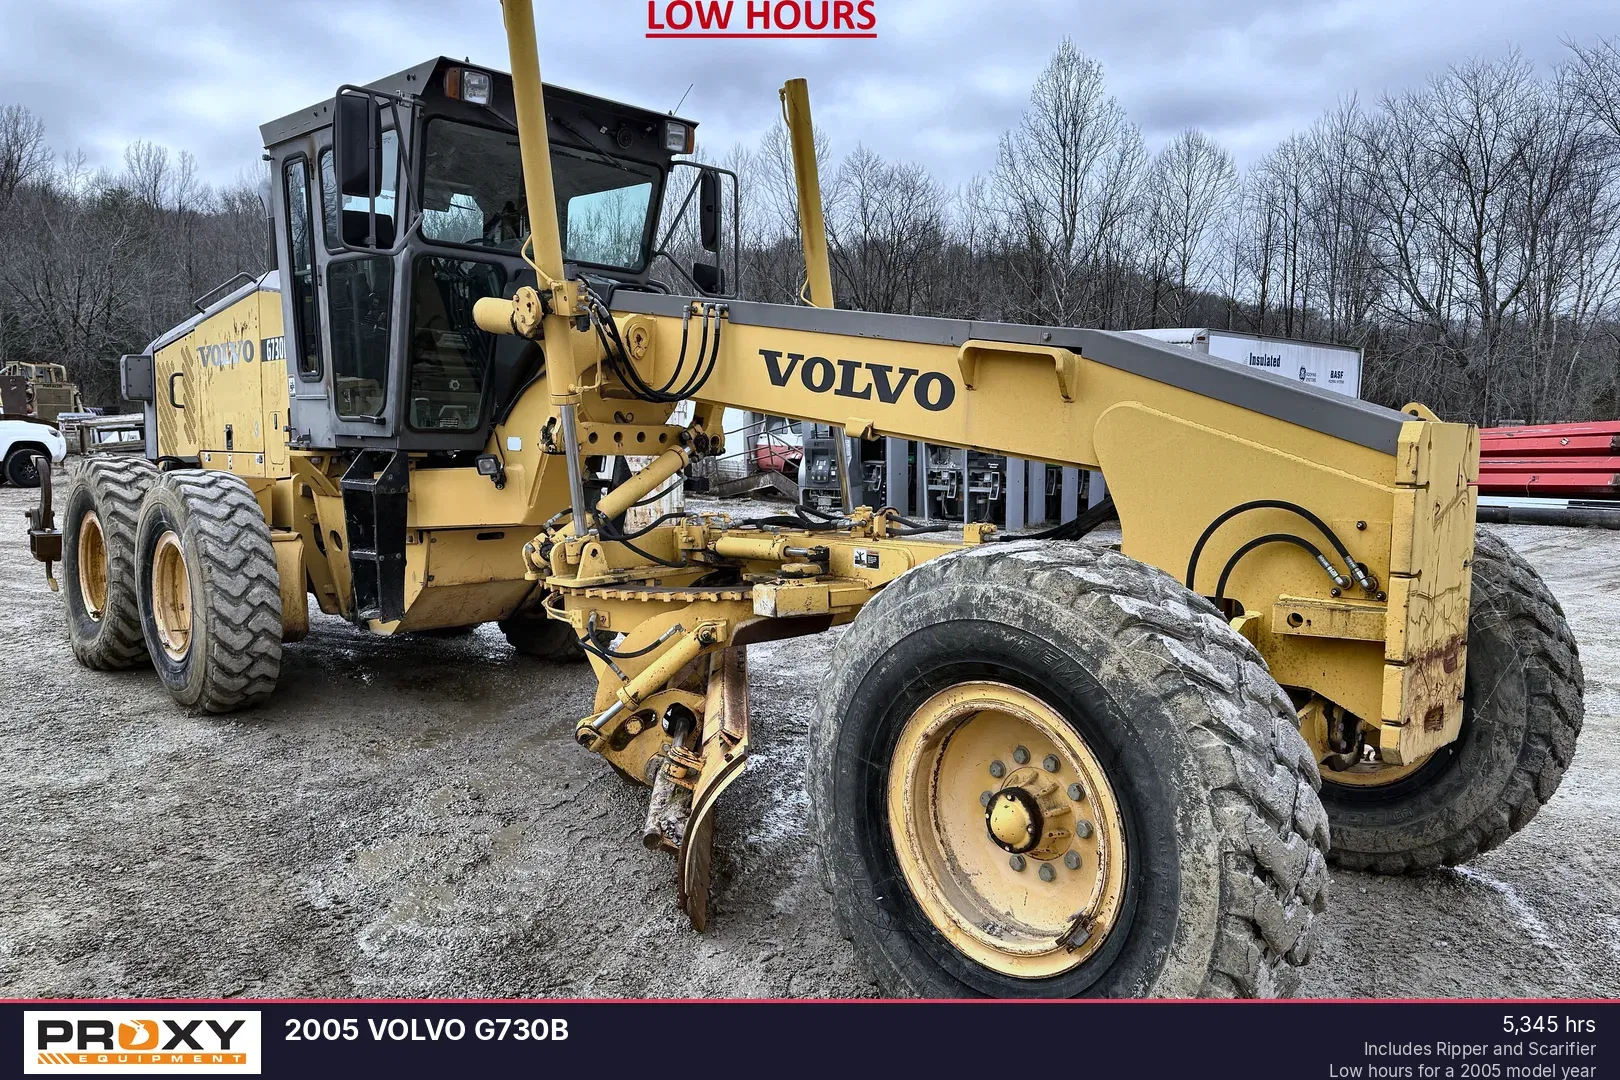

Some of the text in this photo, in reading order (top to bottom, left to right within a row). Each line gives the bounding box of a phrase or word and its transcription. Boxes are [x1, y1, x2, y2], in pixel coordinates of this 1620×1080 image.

[196, 339, 255, 367] VOLVO
[266, 338, 286, 361] G730
[1249, 352, 1281, 367] Insulated
[758, 348, 956, 412] VOLVO
[1330, 370, 1344, 379] BASF
